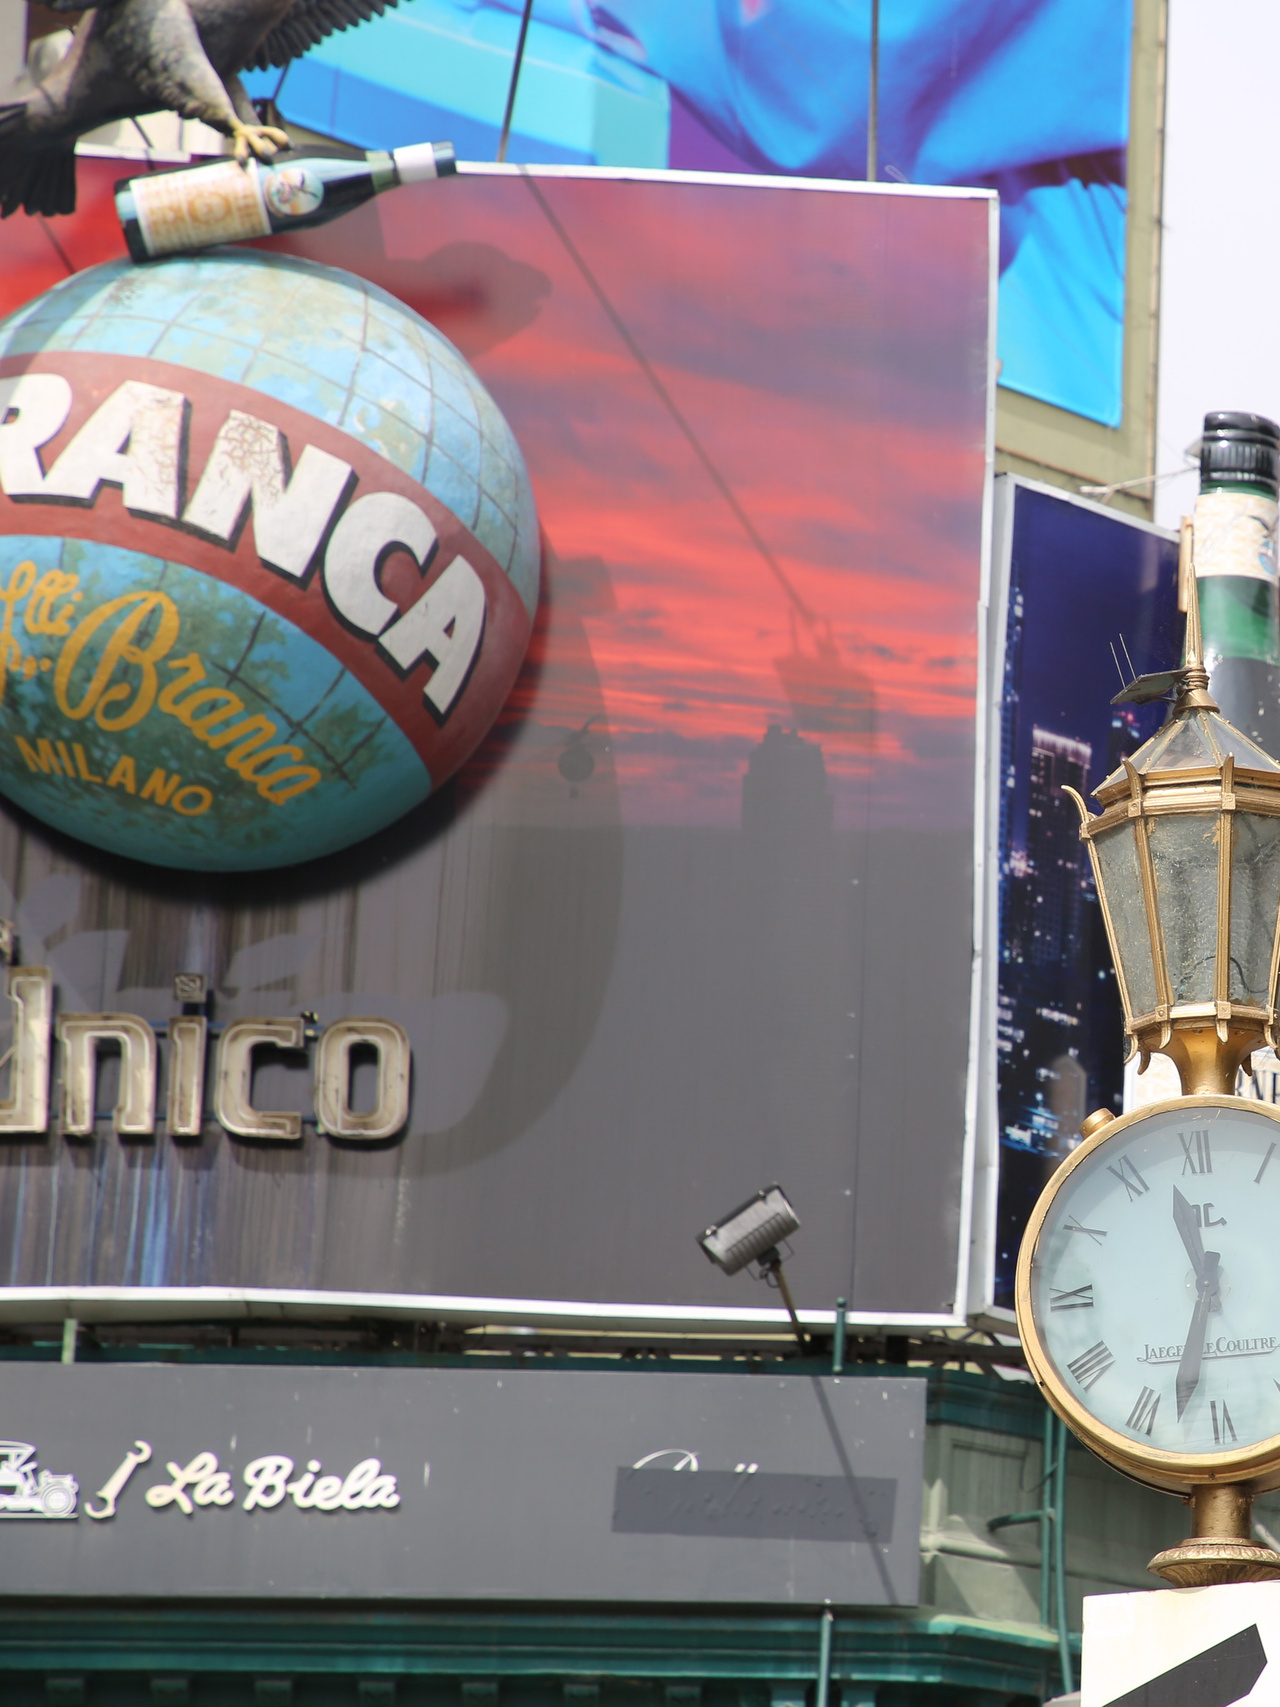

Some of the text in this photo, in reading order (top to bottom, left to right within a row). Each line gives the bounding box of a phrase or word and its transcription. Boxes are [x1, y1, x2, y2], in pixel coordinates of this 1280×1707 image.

[53, 590, 323, 807] Branca
[14, 733, 214, 818] MILANO
[1177, 1130, 1213, 1176] XII
[1106, 1154, 1150, 1202] XI
[1063, 1214, 1108, 1246] X
[1049, 1283, 1094, 1312] IX
[1209, 1399, 1239, 1446] VI
[145, 1450, 401, 1515] La Biela
